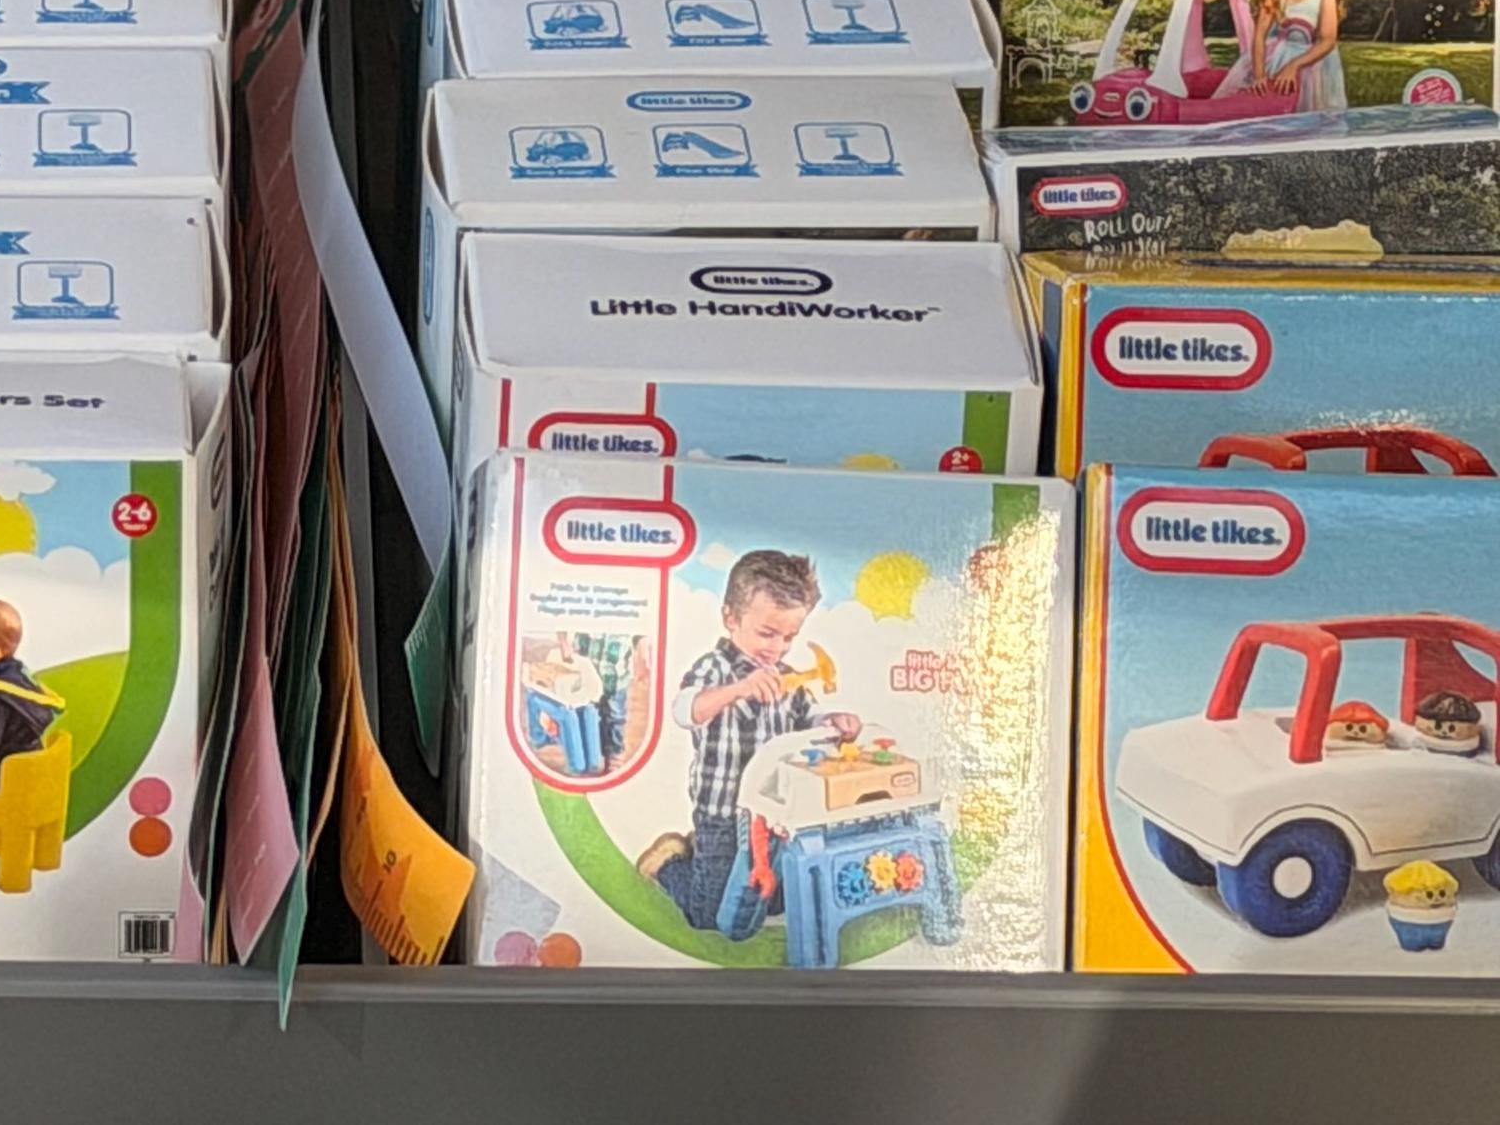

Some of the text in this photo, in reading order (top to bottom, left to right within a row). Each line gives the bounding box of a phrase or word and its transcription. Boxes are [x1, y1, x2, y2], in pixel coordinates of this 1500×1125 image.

[1043, 186, 1117, 204] little tikes
[1084, 213, 1174, 241] ROLL OUT!
[712, 275, 758, 286] little
[591, 299, 928, 323] Little HandiWorker
[1118, 336, 1244, 362] little tikes
[42, 393, 107, 410] Set
[551, 432, 654, 453] little tikes
[950, 449, 971, 465] 2+
[117, 501, 152, 523] 2-6
[566, 520, 673, 545] little tikes
[1145, 516, 1277, 546] little tikes
[891, 668, 933, 692] BIG
[381, 849, 398, 874] 10
